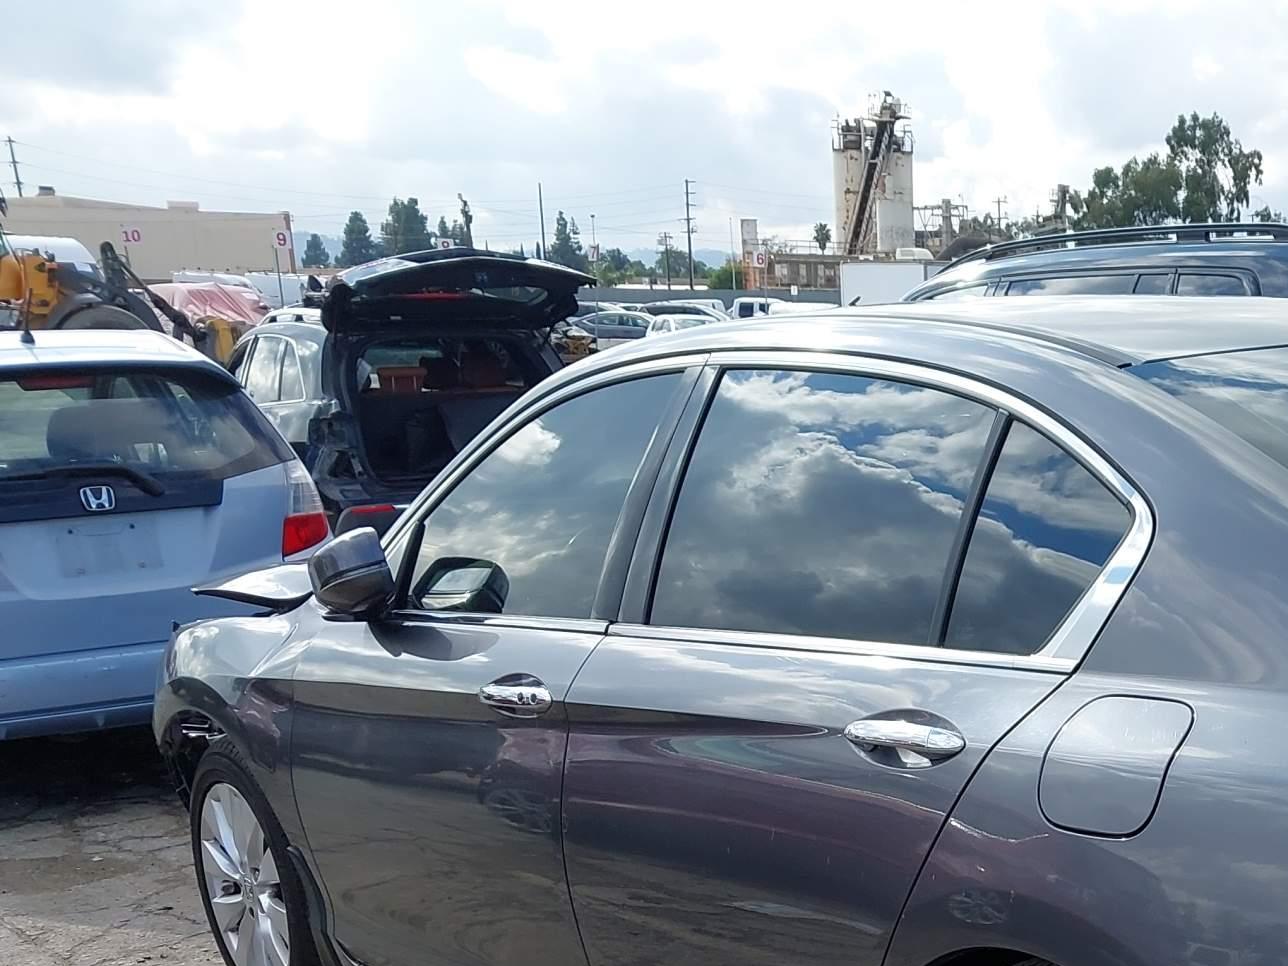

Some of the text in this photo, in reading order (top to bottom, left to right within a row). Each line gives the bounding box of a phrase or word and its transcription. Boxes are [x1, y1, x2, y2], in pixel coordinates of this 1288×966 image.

[122, 230, 141, 242] 10
[276, 231, 287, 247] 9
[756, 252, 764, 265] 6
